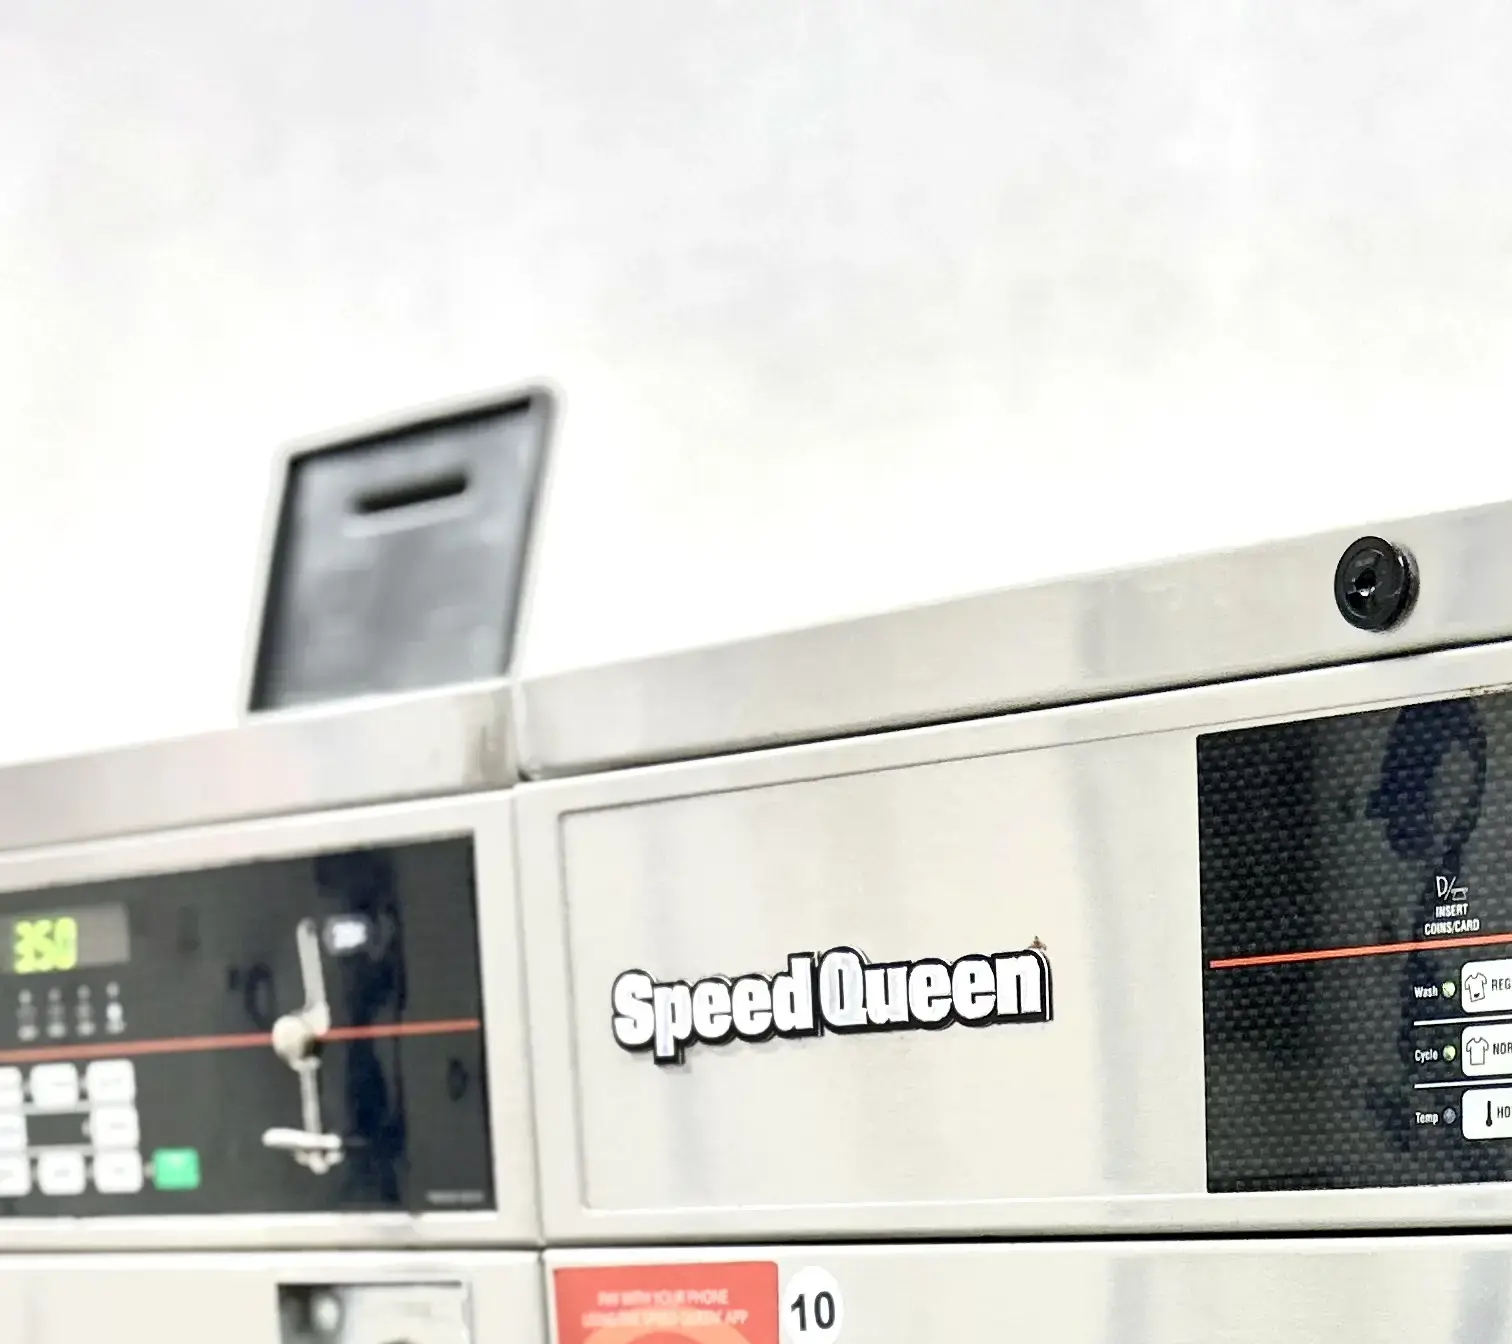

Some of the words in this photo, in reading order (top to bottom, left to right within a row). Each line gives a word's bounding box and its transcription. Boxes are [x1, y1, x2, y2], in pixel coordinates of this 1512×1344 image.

[1435, 903, 1469, 918] INSERT
[1424, 918, 1480, 935] COINS/CARD
[1414, 986, 1438, 998] Wash
[1414, 1050, 1438, 1063] Cycle
[1415, 1112, 1439, 1126] Temp
[790, 1290, 836, 1332] 10
